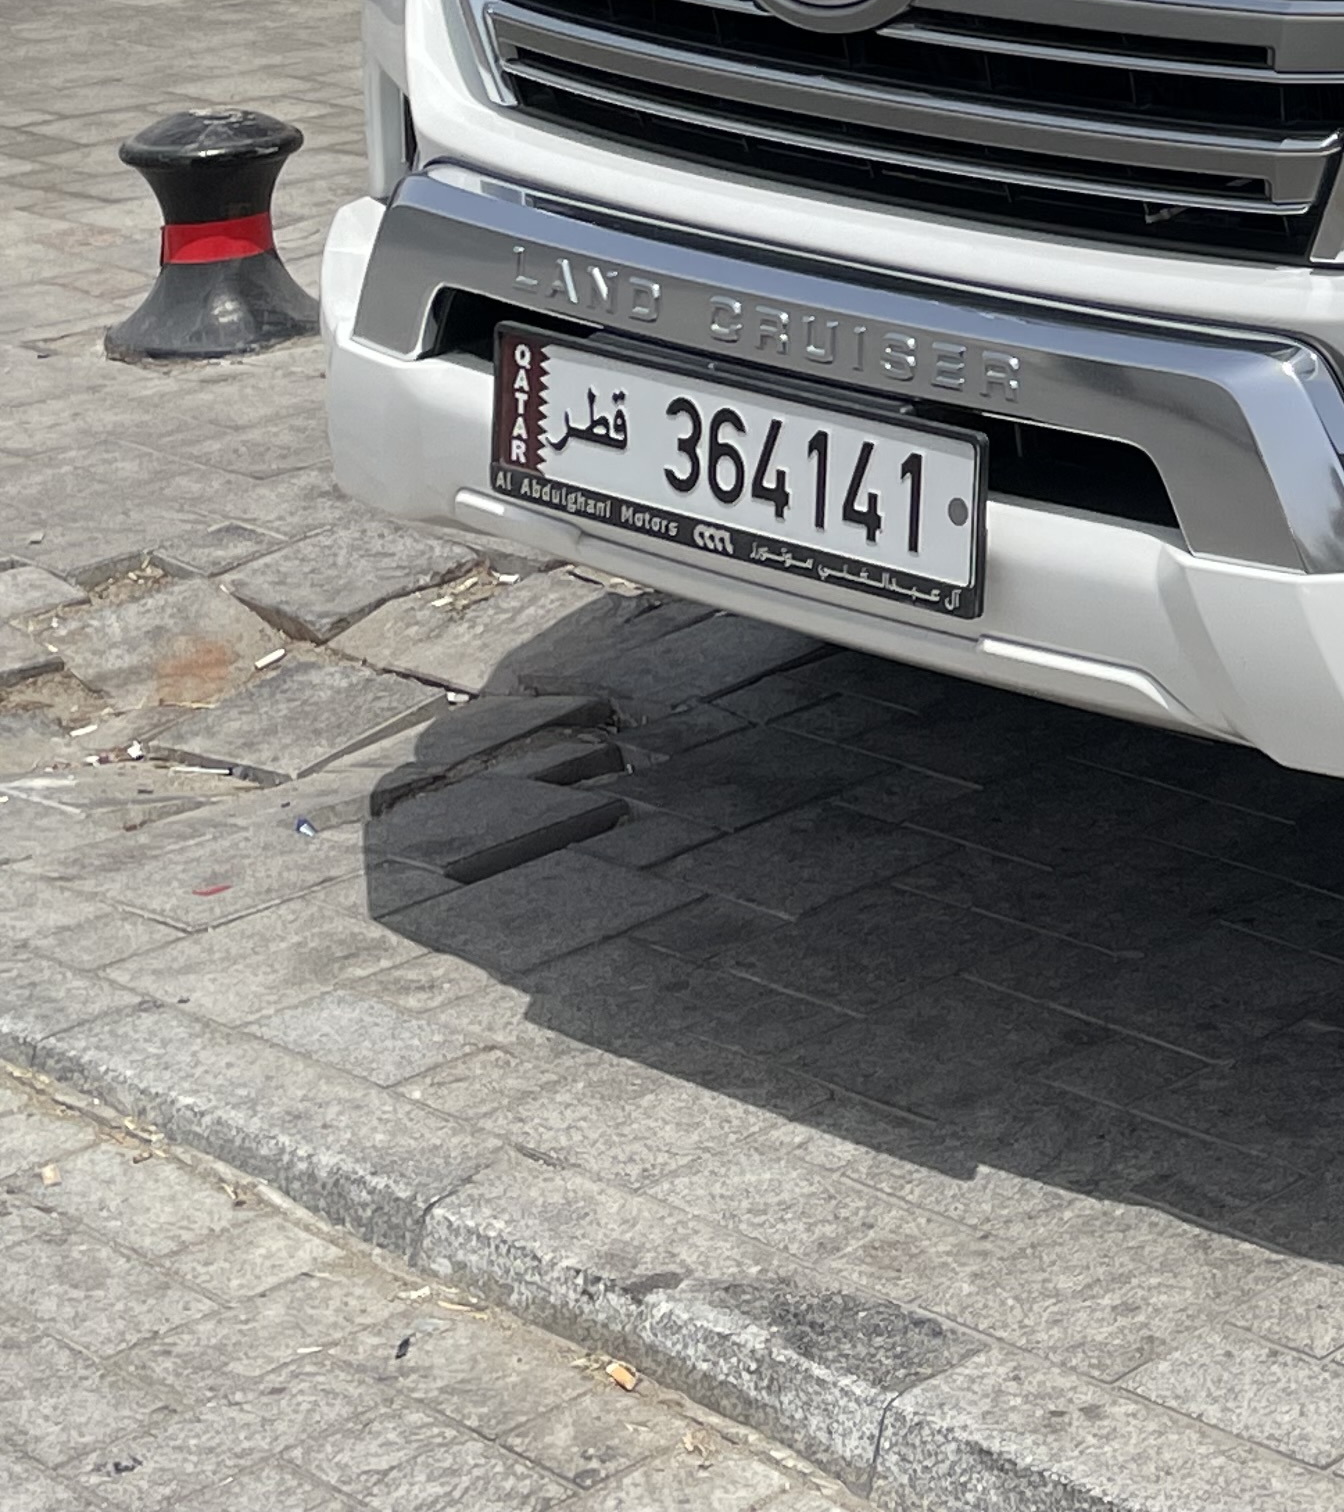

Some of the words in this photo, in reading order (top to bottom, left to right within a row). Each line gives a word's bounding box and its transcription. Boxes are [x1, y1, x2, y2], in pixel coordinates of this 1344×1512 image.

[511, 245, 662, 323] LAND
[709, 294, 1020, 403] CRUISER
[510, 343, 532, 465] QATAR
[545, 385, 629, 453] قطر
[663, 396, 923, 555] 364141
[619, 504, 680, 537] Motors
